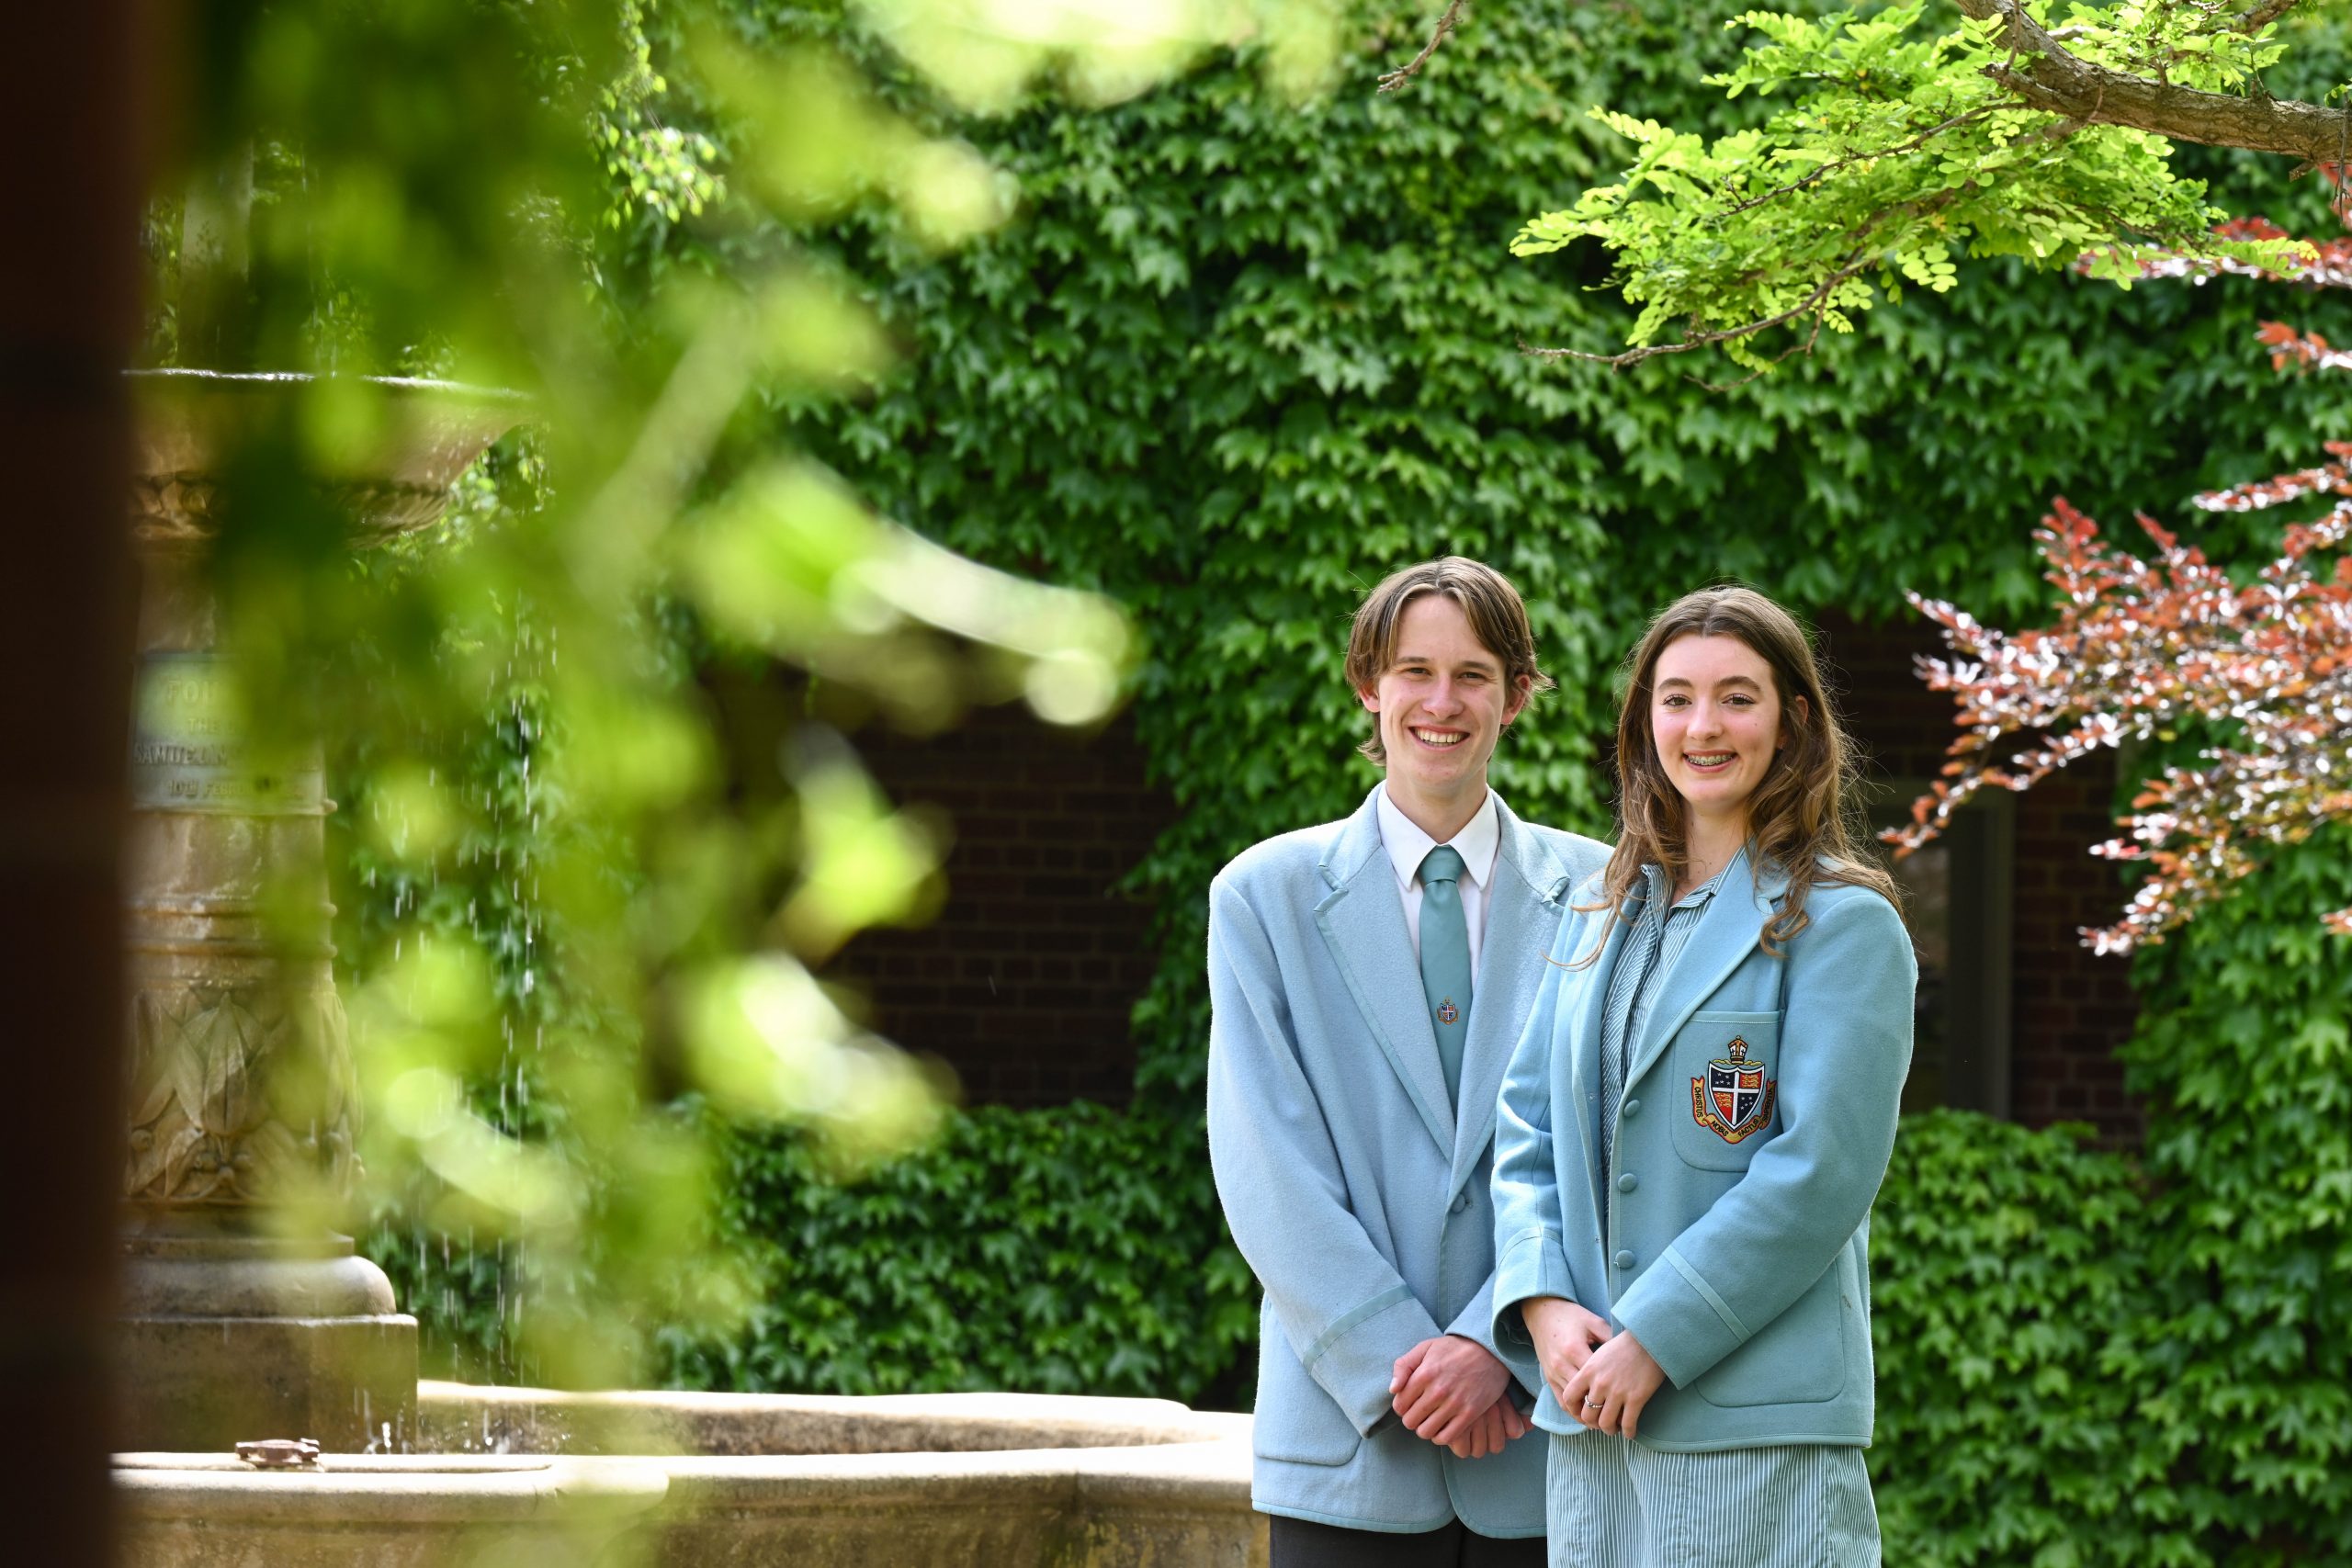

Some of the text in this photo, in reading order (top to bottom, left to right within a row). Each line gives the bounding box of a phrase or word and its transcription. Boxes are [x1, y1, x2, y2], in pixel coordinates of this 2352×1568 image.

[134, 744, 209, 765] SAMUEL
[1693, 1087, 1704, 1118] CHRISTUS
[1710, 1120, 1729, 1137] NOBIS
[1737, 1117, 1760, 1138] FACTUS
